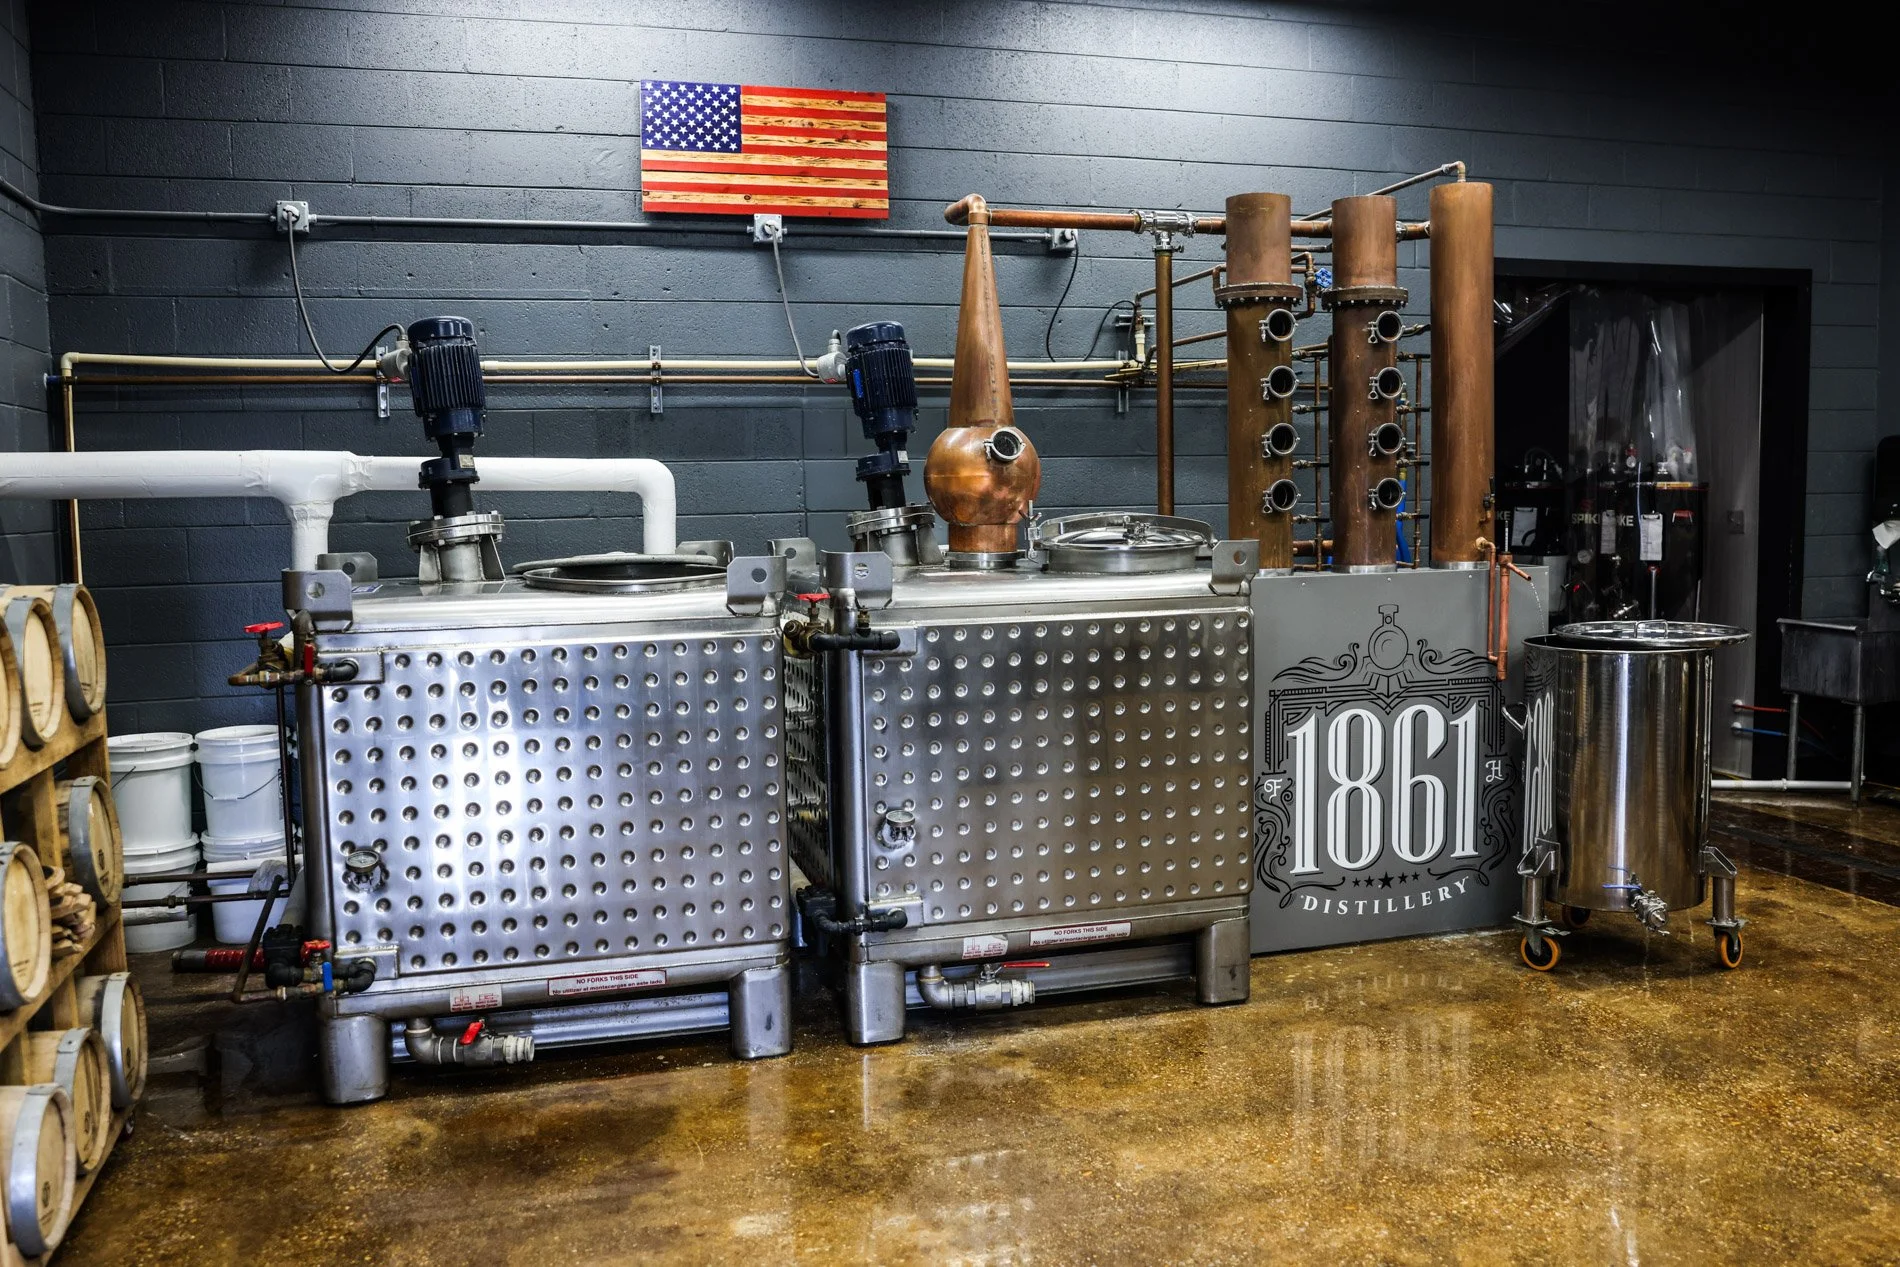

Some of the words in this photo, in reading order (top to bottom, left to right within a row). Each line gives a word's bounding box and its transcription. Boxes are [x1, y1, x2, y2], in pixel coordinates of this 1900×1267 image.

[1286, 702, 1479, 874] 1861
[1302, 877, 1469, 915] DISTILLERY
[587, 976, 608, 984] FORKS
